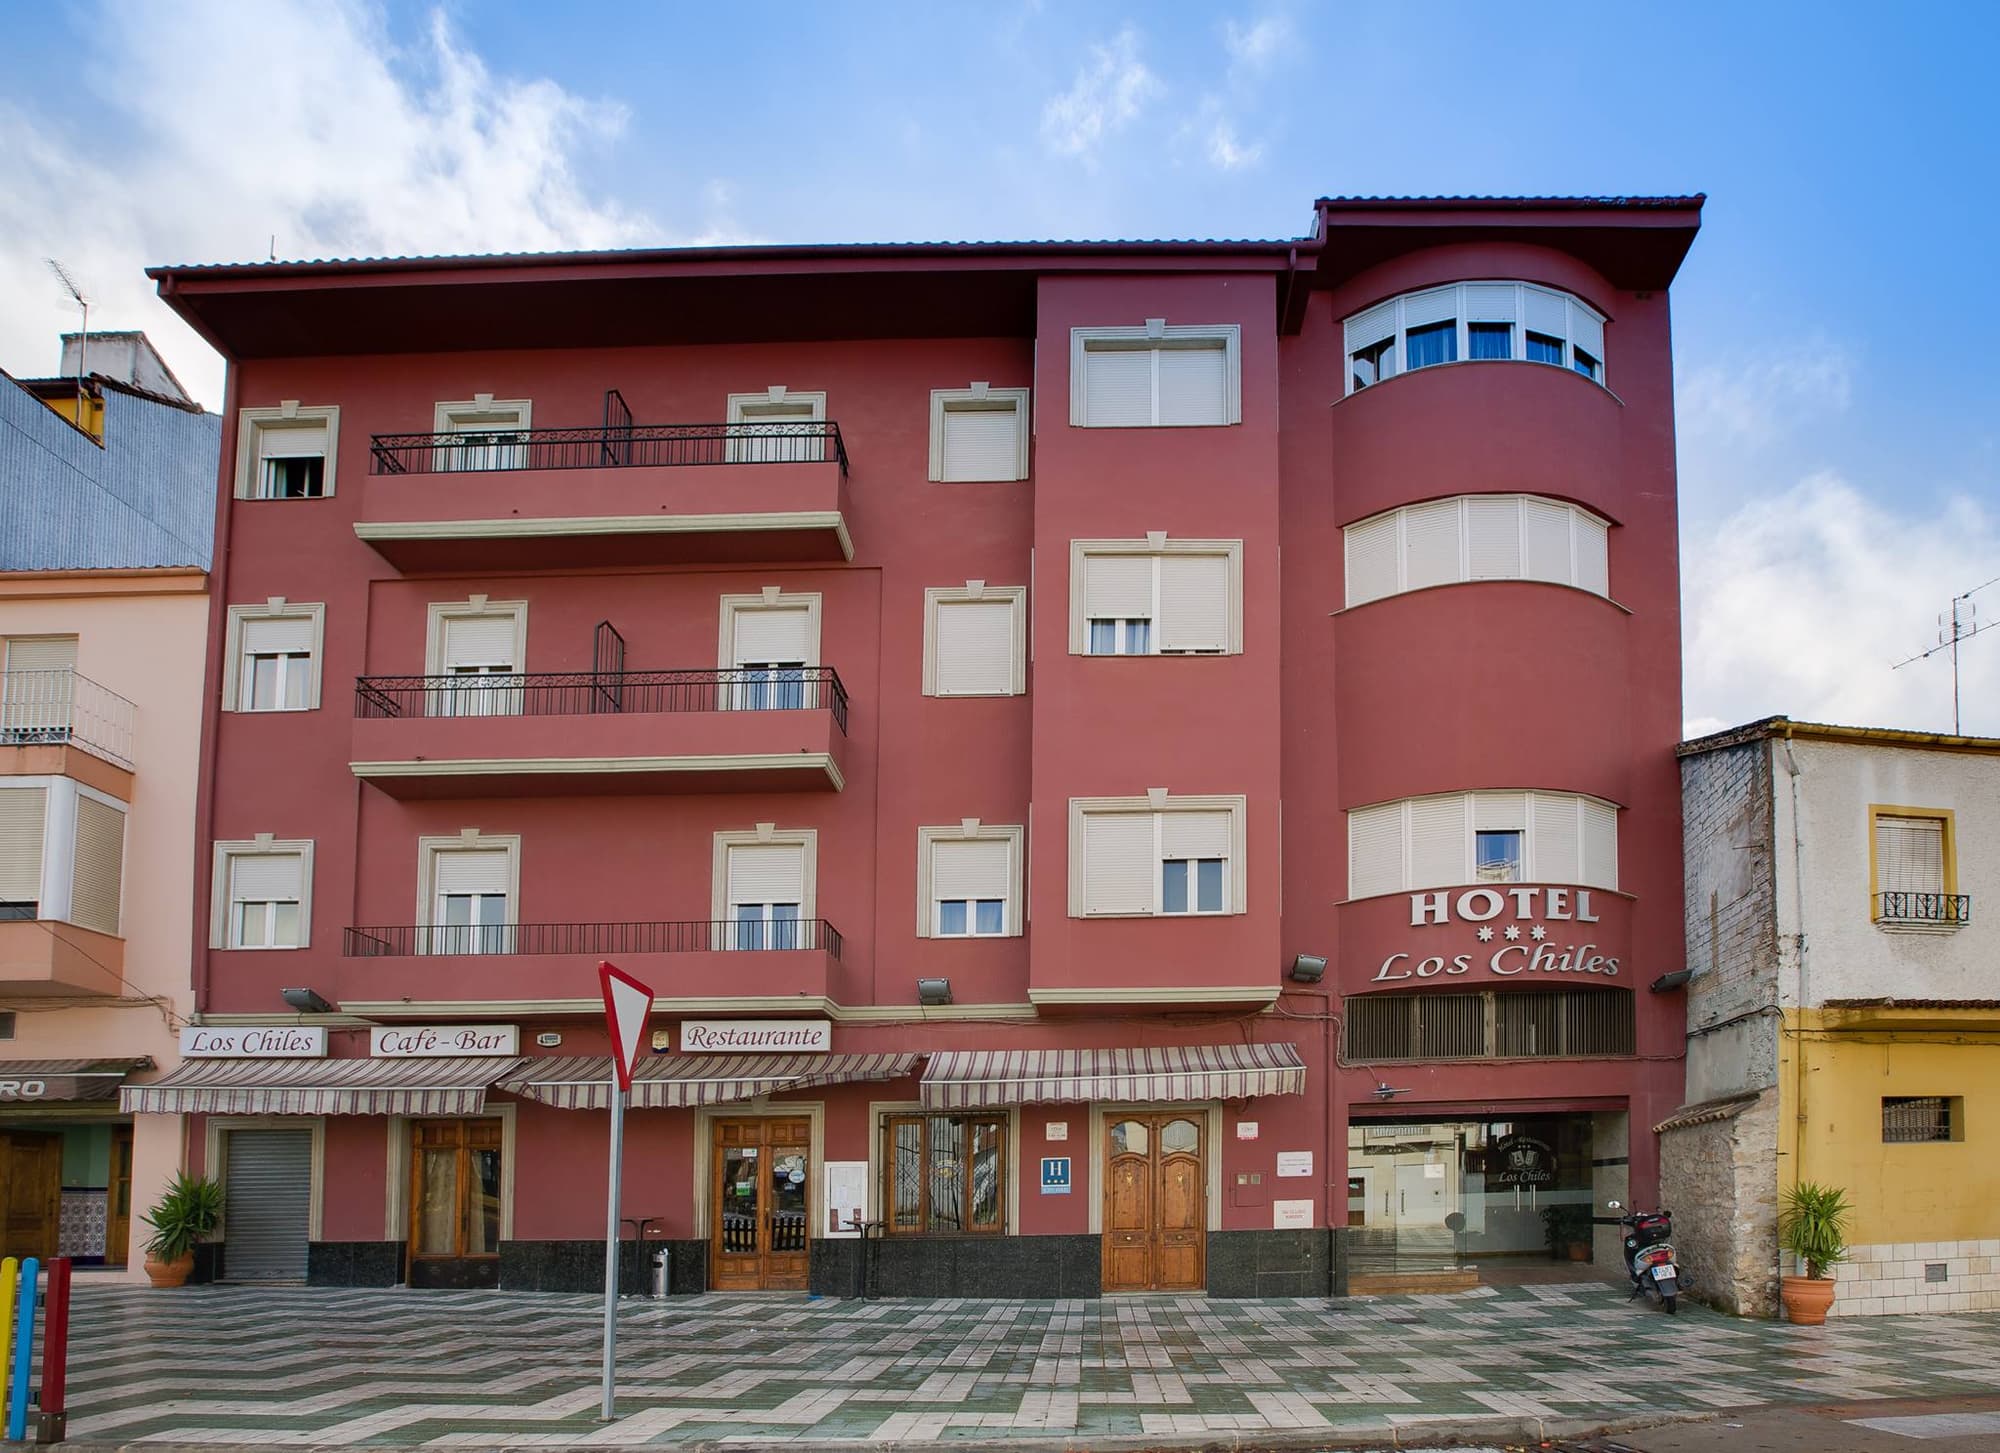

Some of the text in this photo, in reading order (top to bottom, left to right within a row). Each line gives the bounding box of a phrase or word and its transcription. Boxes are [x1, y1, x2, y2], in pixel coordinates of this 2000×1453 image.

[1410, 888, 1600, 926] HOTEL
[1371, 942, 1620, 981] Los Chiles
[191, 1029, 313, 1053] Los Chiles
[687, 1025, 823, 1049] Restaurante
[1050, 1161, 1062, 1177] H
[1498, 1169, 1552, 1183] Los Chiles
